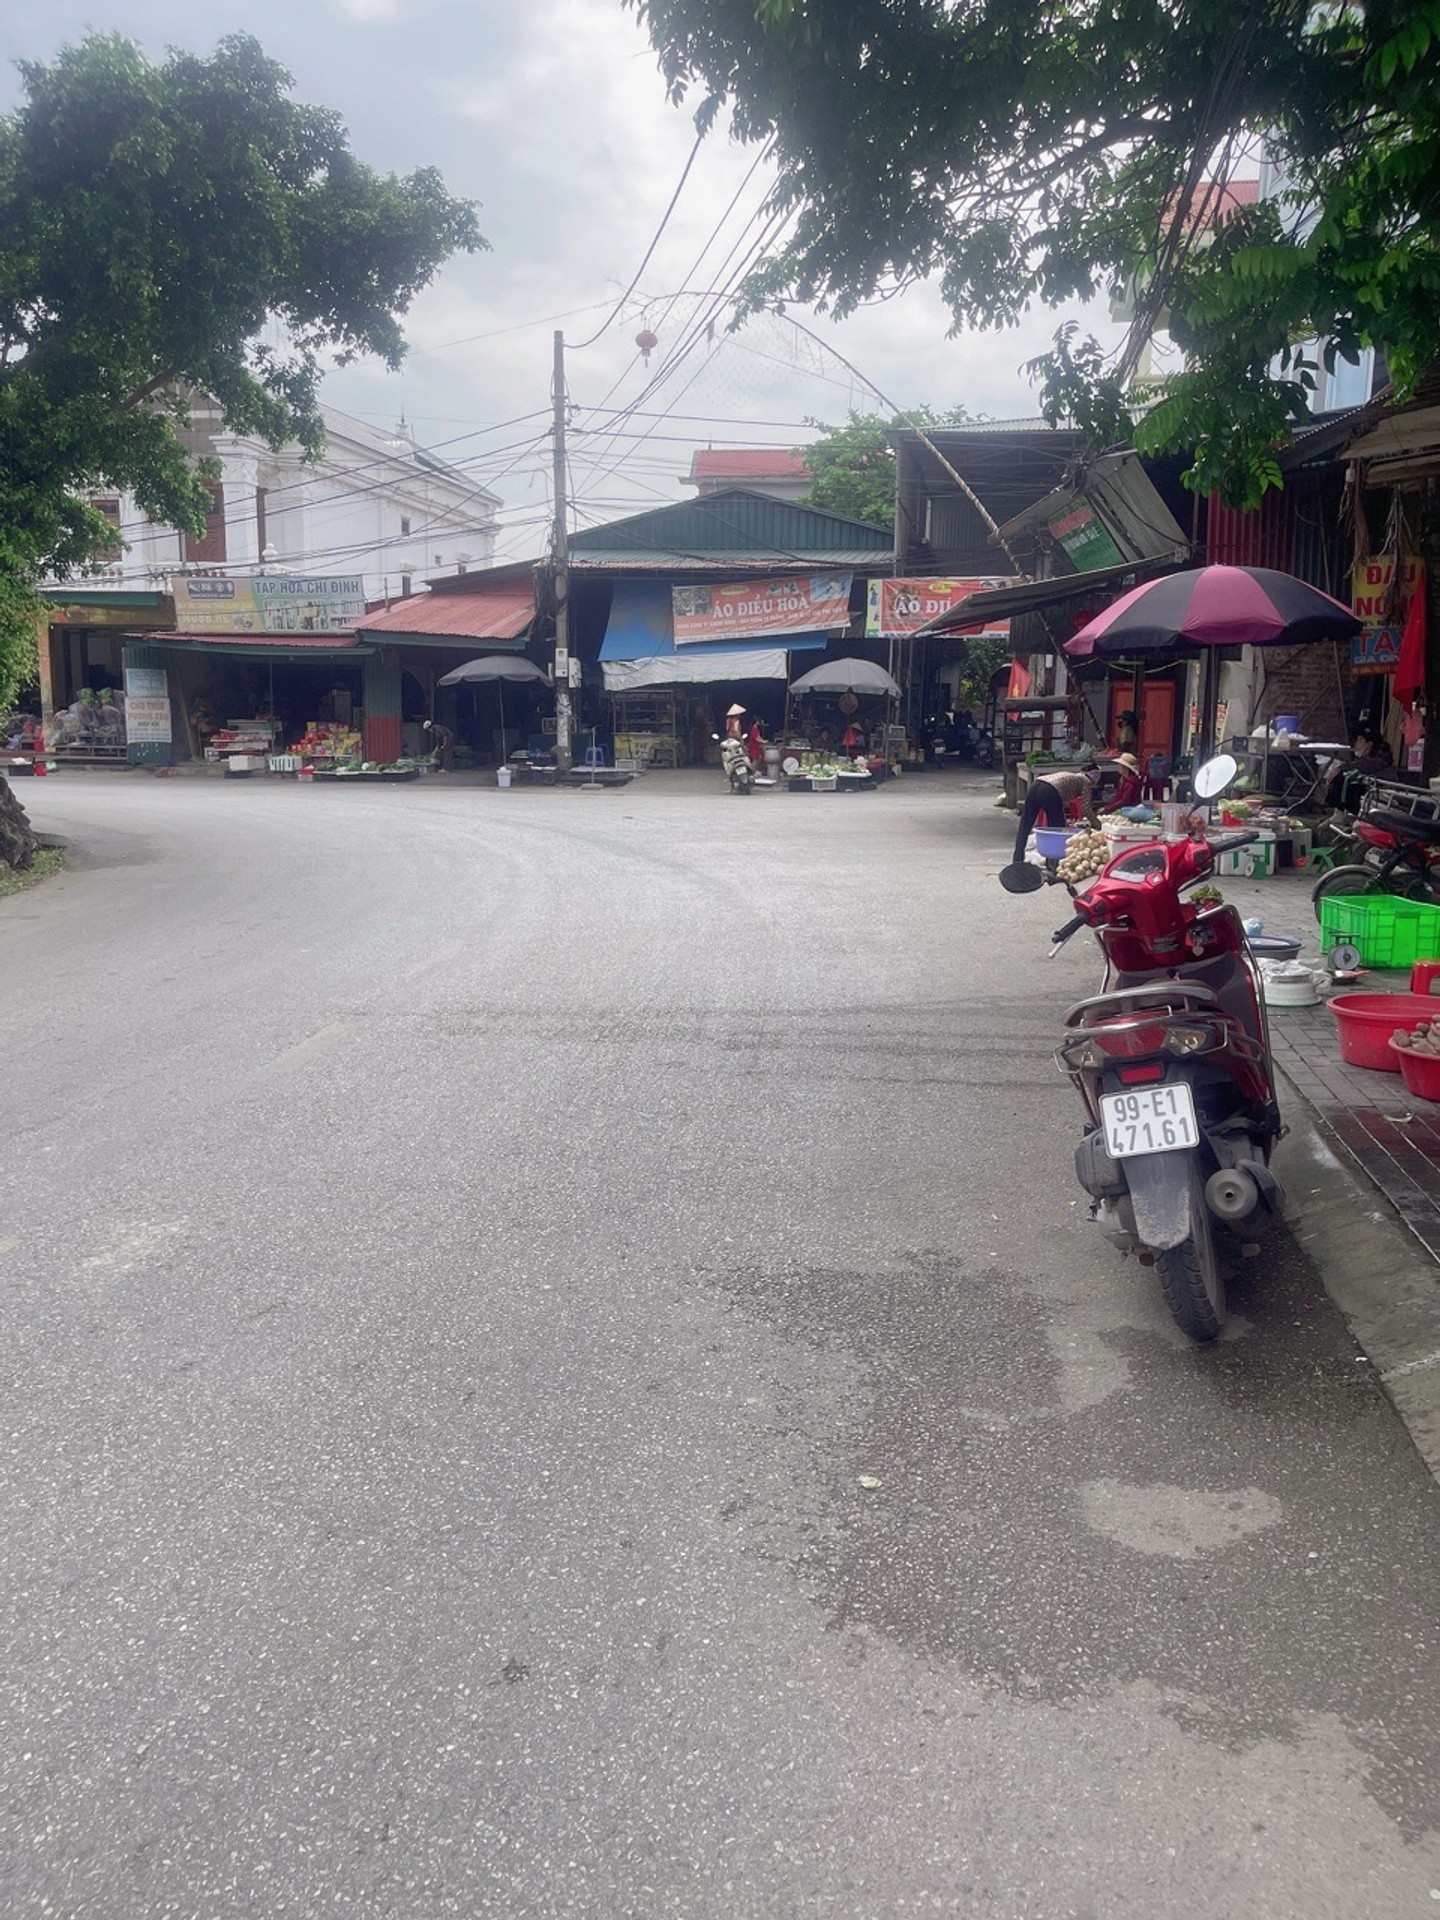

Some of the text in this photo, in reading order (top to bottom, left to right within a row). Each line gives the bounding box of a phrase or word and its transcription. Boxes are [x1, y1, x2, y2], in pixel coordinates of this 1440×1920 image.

[712, 600, 734, 619] ÁO
[1113, 1088, 1177, 1123] 99-E1
[1112, 1117, 1190, 1153] 471.61
